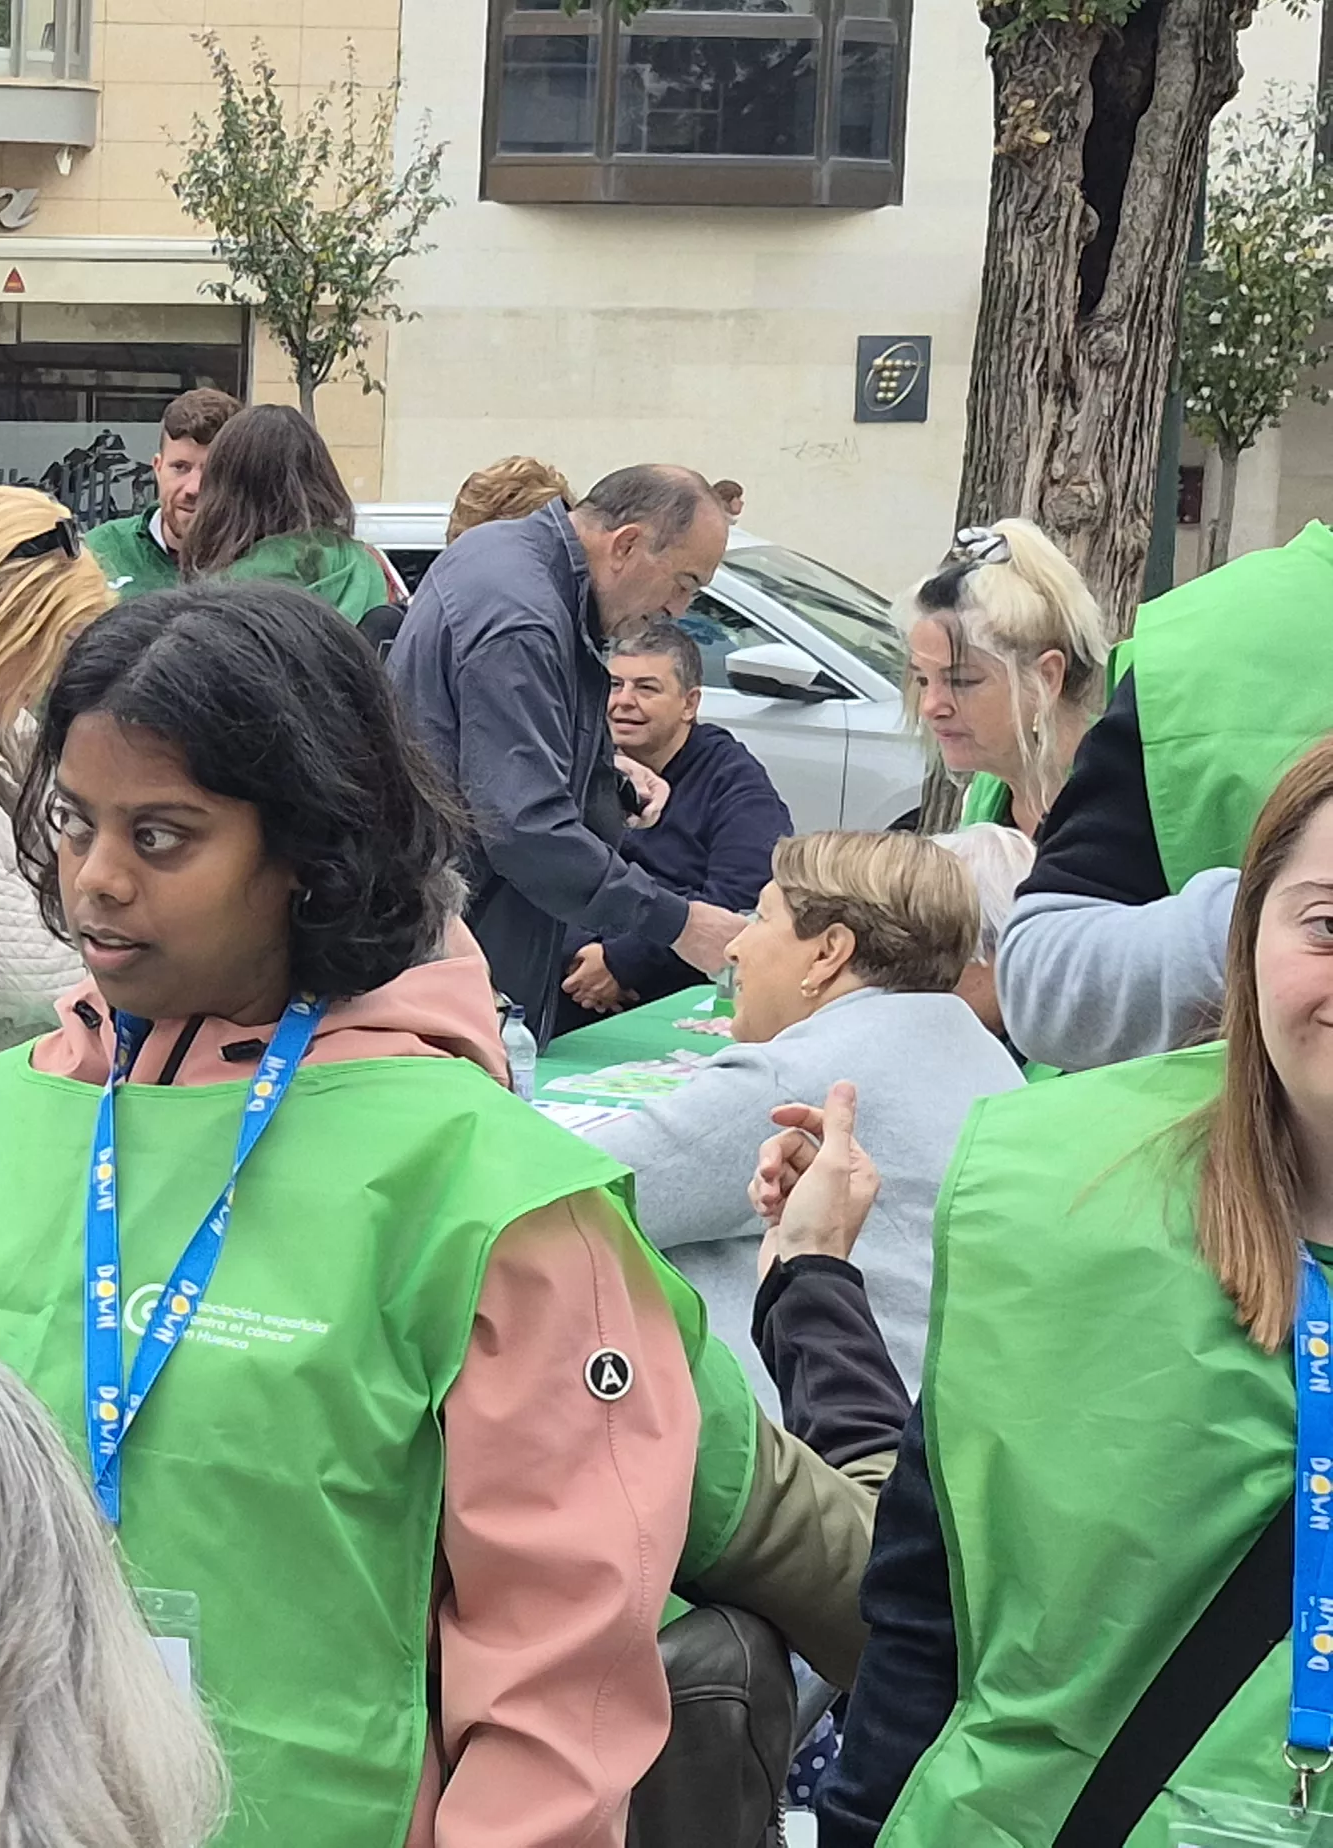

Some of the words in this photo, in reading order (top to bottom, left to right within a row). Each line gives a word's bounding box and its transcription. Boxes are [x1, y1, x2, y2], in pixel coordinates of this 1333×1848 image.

[96, 1264, 118, 1330] DOWN
[190, 1315, 227, 1331] ontra
[1306, 1320, 1332, 1394] DOWN
[1309, 1456, 1333, 1532] DOWN
